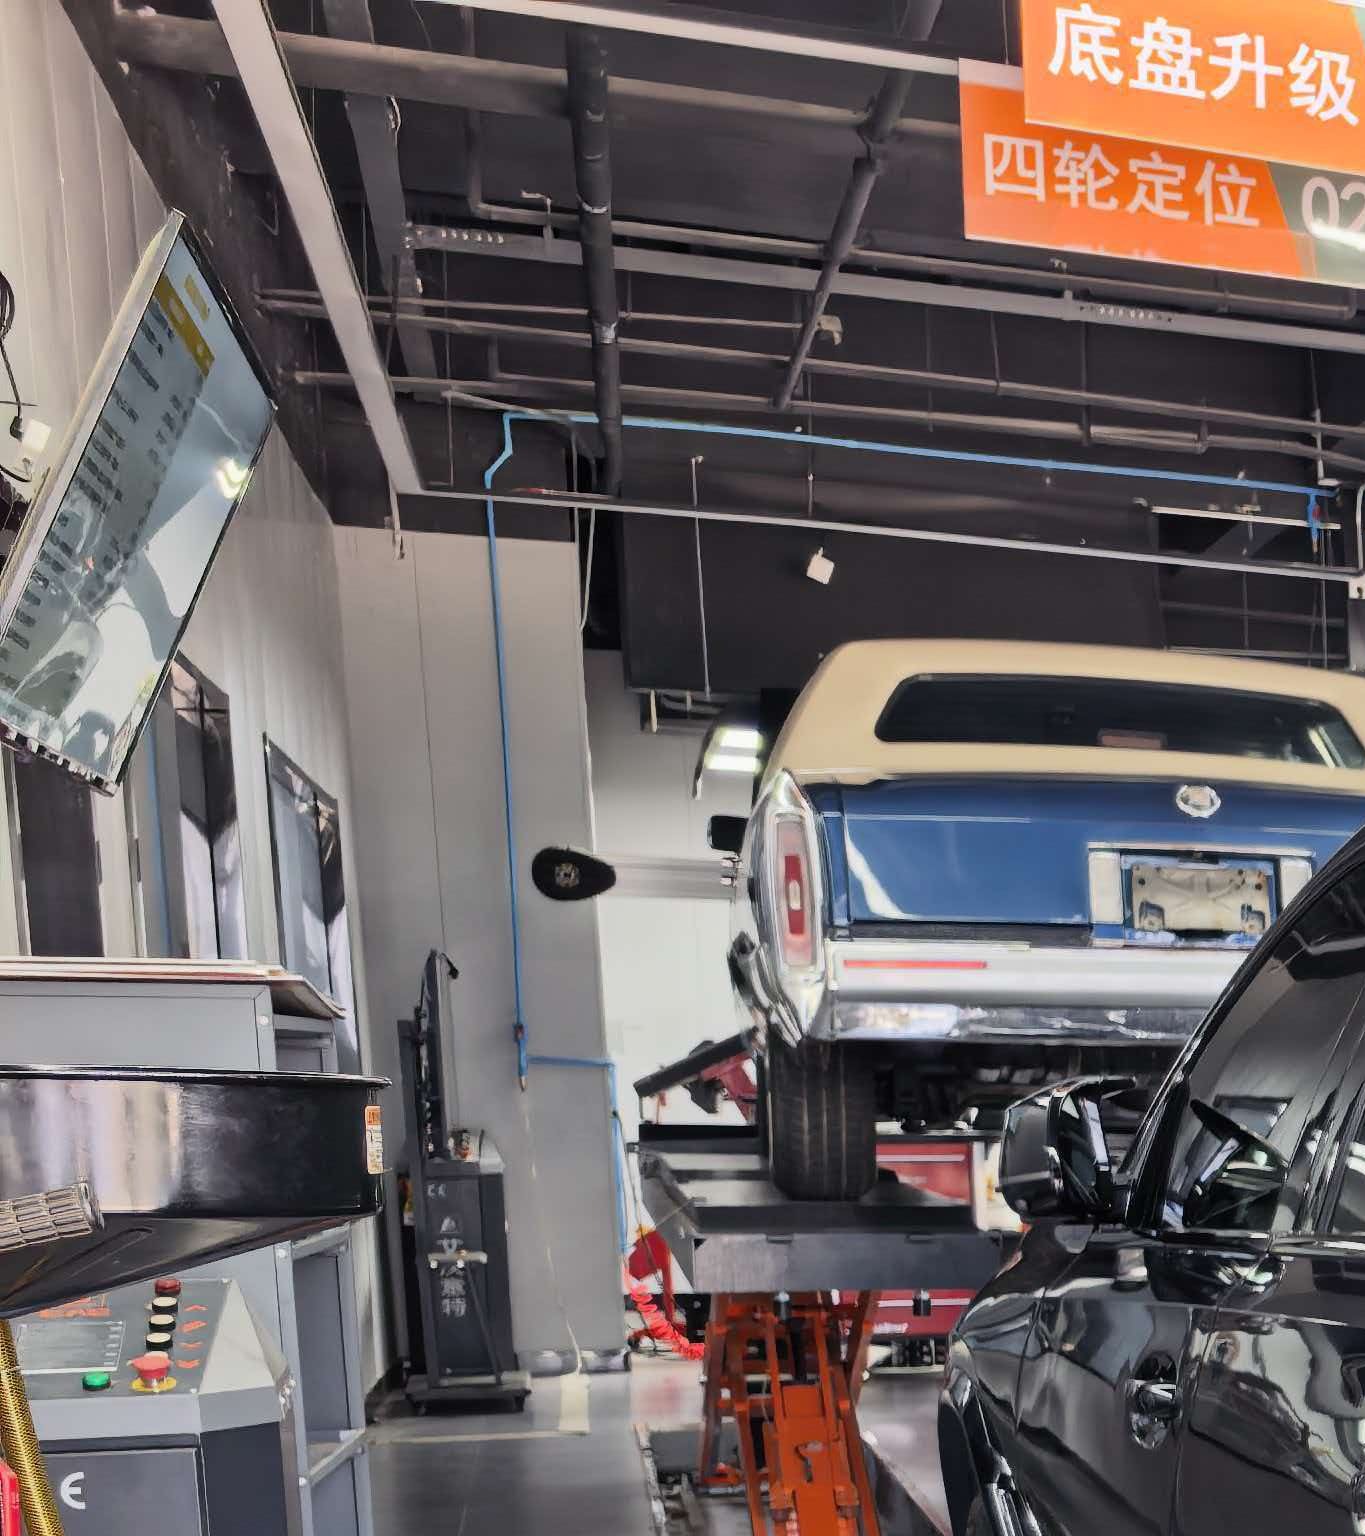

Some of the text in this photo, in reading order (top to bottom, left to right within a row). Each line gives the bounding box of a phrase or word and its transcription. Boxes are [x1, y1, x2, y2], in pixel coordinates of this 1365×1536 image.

[1048, 4, 1358, 126] 底盘升级
[983, 132, 1260, 229] 四轮定位
